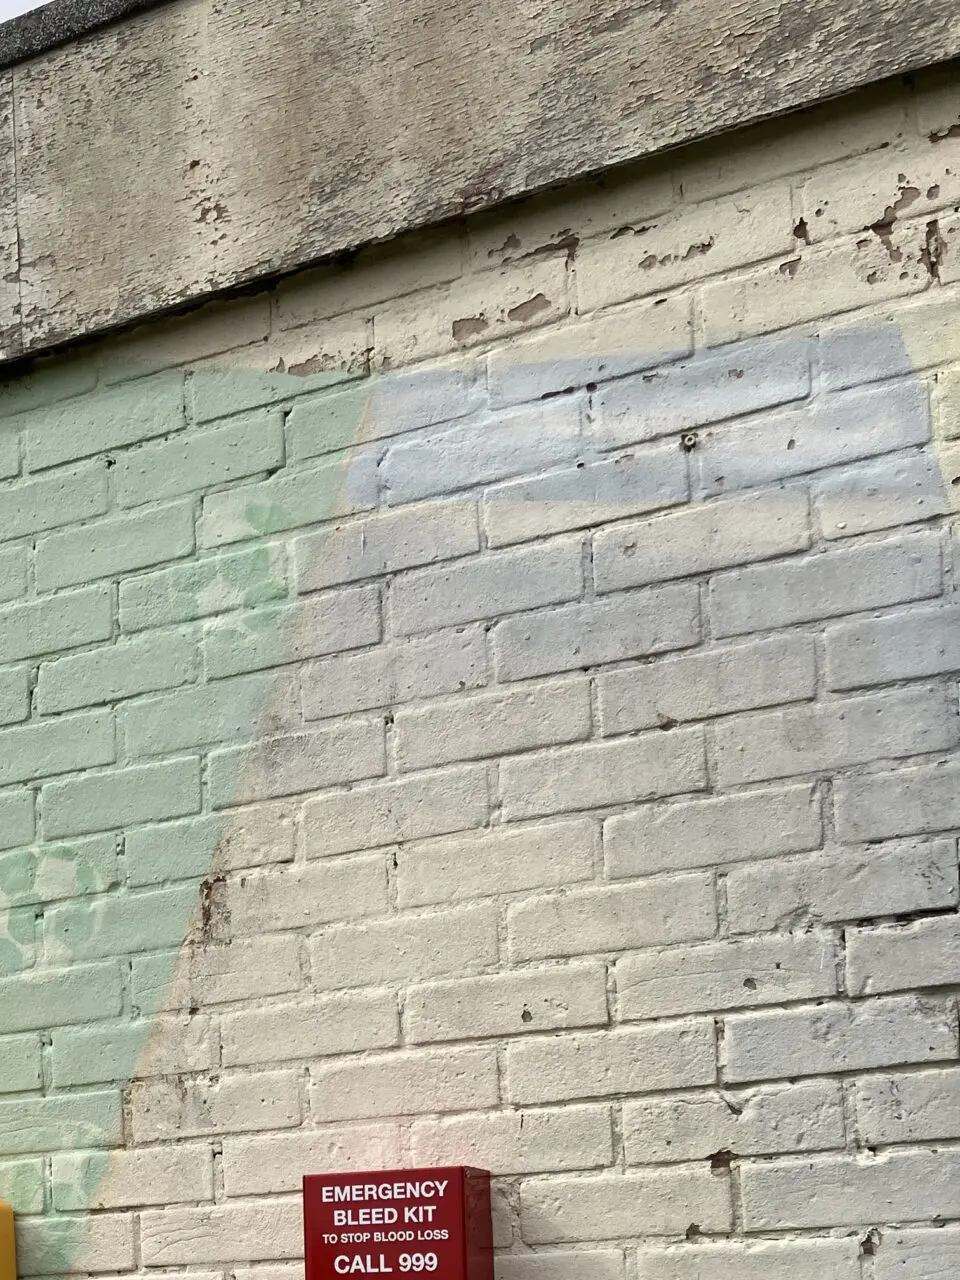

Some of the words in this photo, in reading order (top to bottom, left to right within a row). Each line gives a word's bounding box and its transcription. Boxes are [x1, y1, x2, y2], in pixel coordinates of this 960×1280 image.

[321, 1180, 448, 1202] EMERGENCY
[333, 1207, 398, 1226] BLEED
[404, 1205, 437, 1223] KIT
[322, 1234, 338, 1244] TO
[340, 1232, 371, 1243] STOP
[373, 1231, 415, 1242] BLOOD
[417, 1229, 449, 1240] LOSS
[334, 1254, 393, 1274] CALL
[398, 1252, 438, 1272] 999
